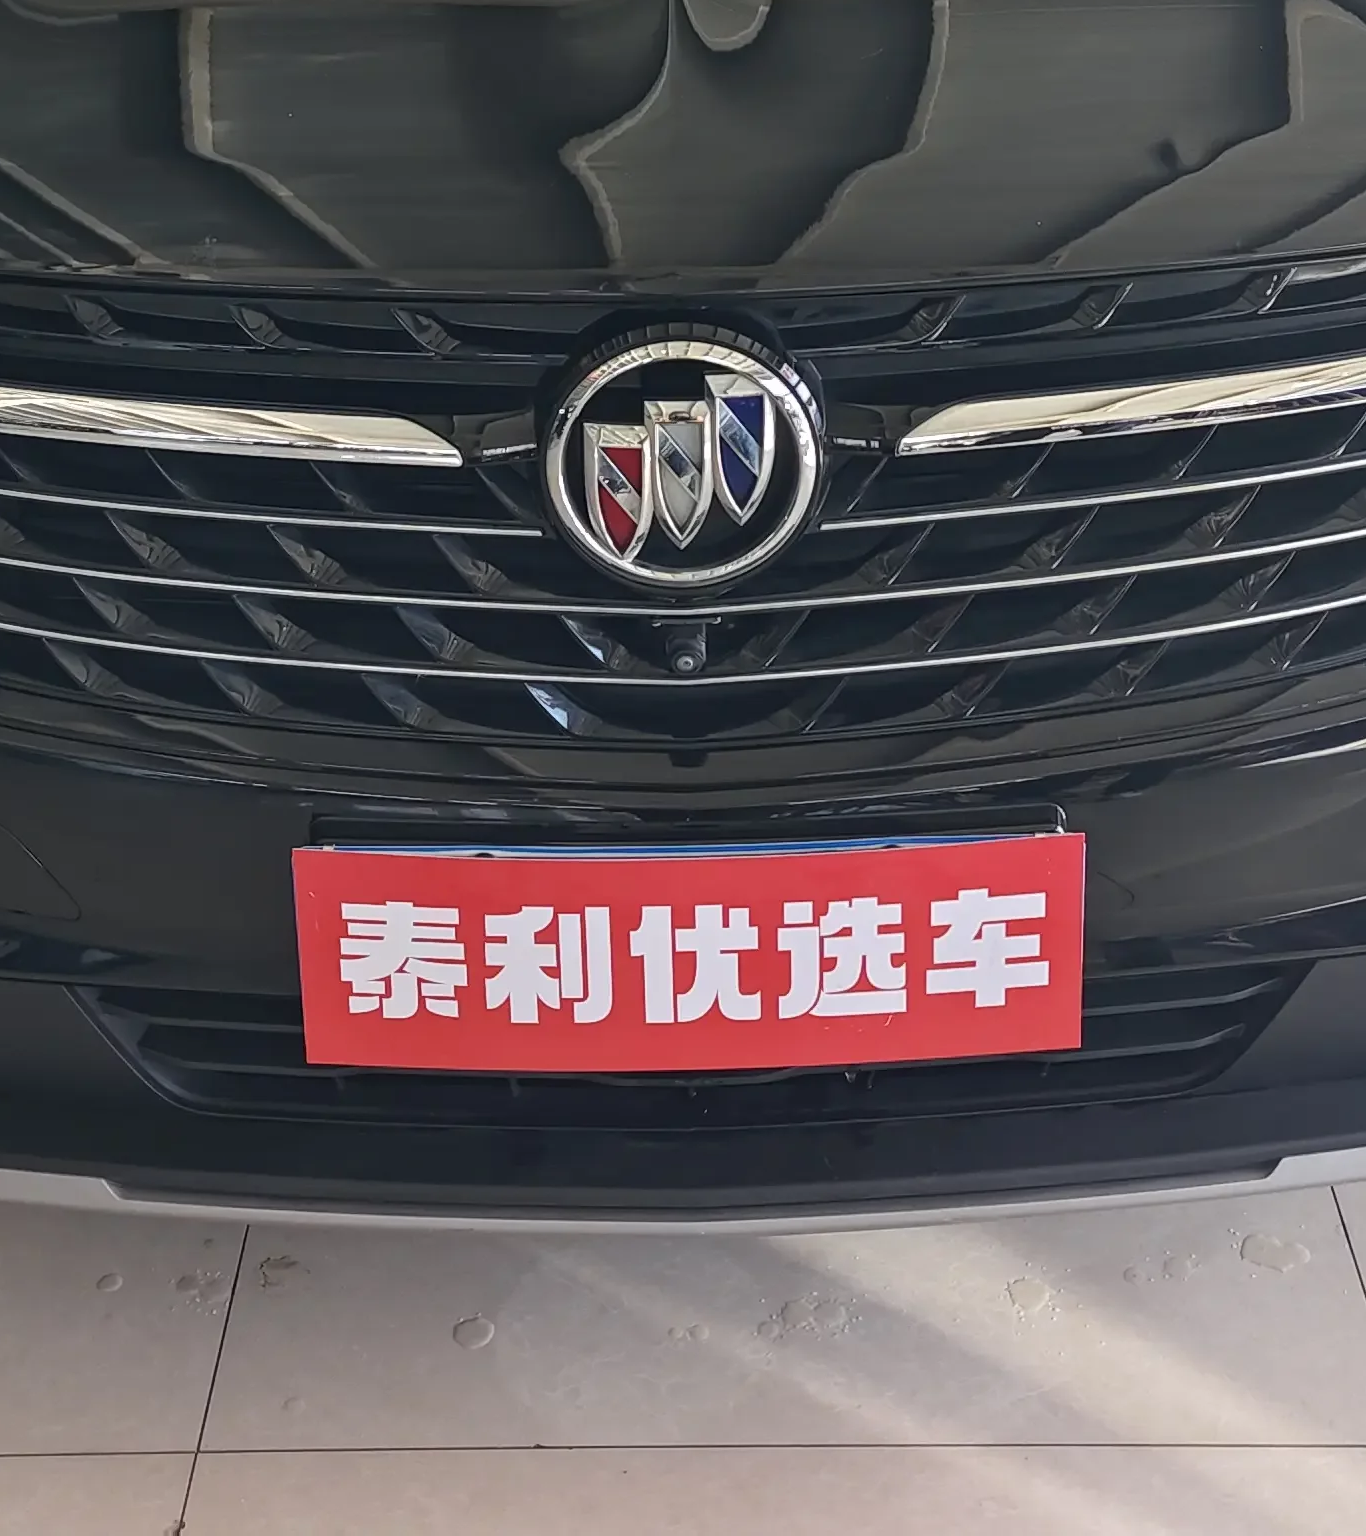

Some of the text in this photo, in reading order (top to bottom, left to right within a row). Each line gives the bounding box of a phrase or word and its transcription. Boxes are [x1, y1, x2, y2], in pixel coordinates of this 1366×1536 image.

[339, 888, 1050, 1025] 泰利优选车
